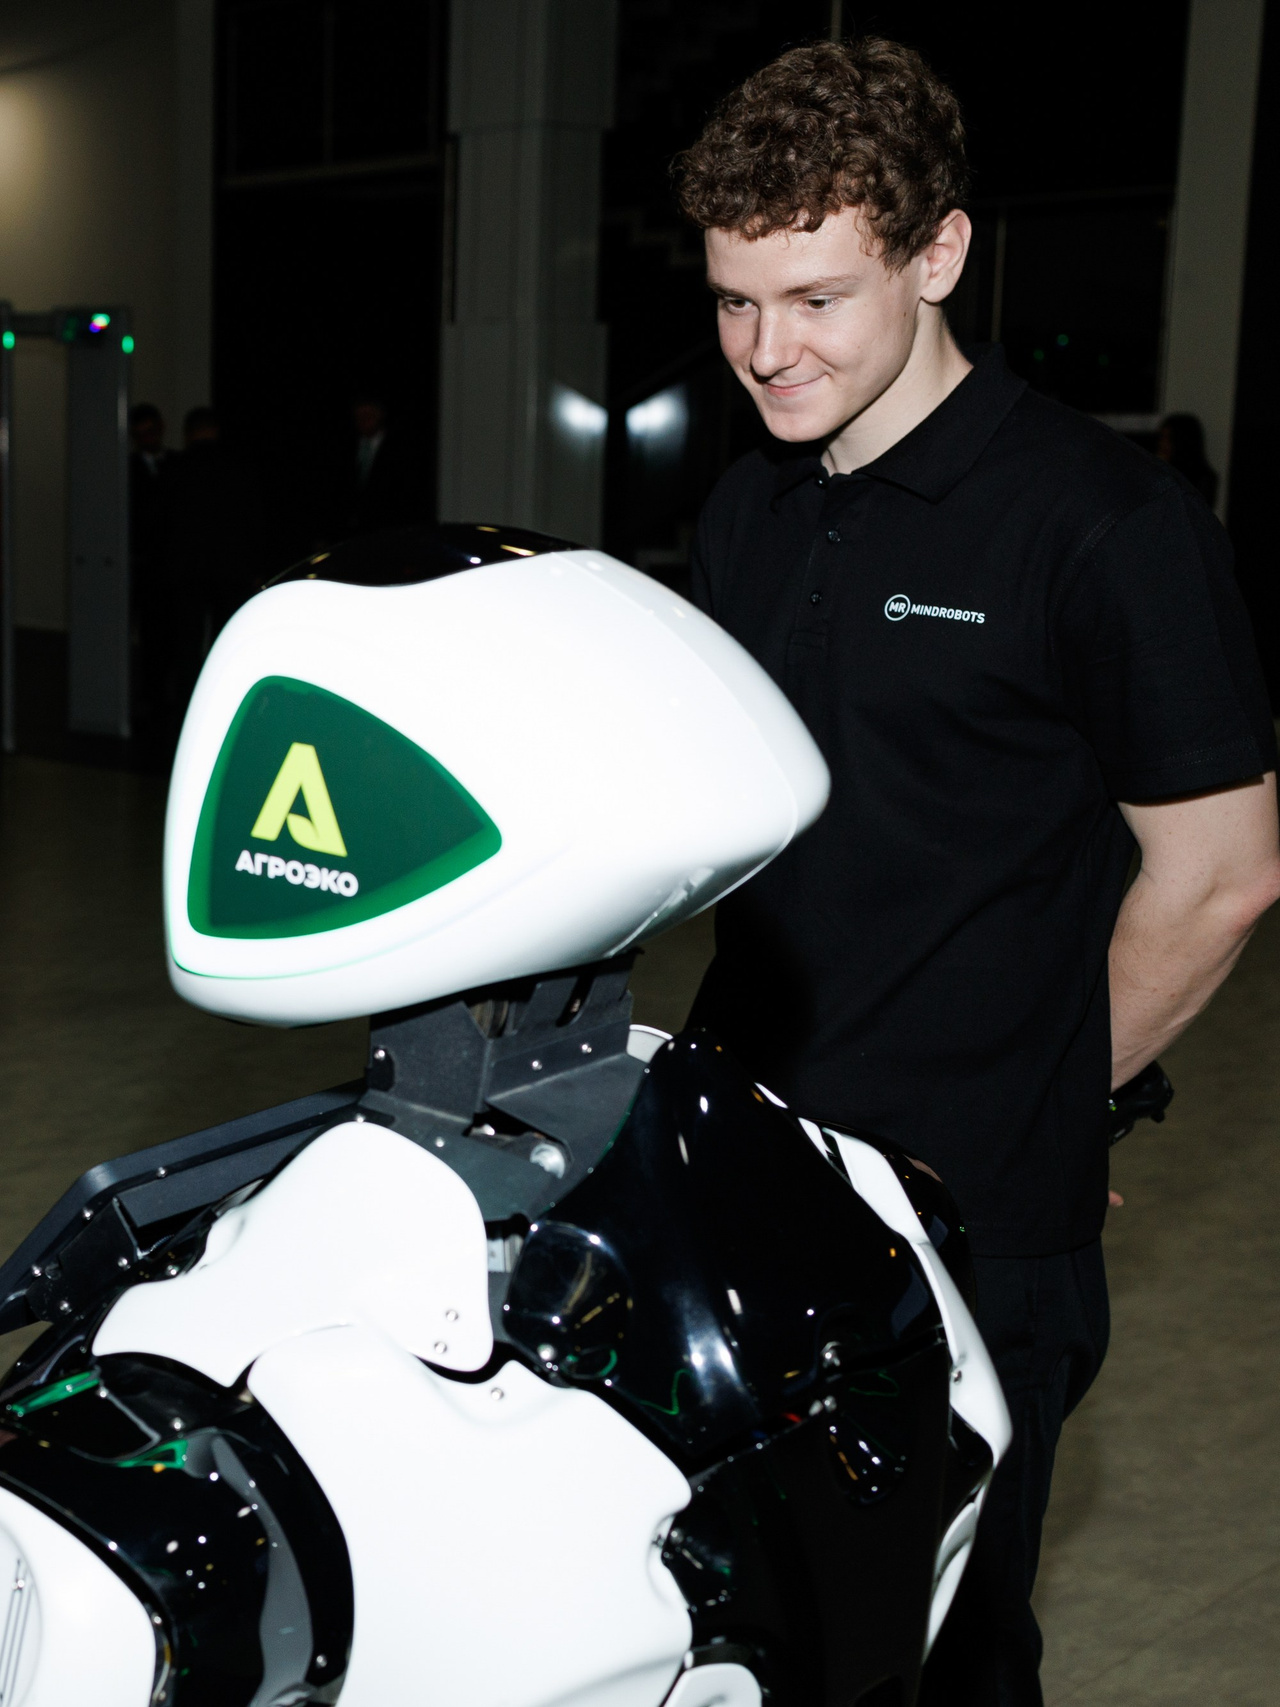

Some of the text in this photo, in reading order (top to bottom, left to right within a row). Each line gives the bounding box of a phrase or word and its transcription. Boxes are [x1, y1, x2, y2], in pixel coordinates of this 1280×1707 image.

[888, 601, 986, 624] MR MINDROBOTS
[235, 849, 359, 897] АГРОЭКО
